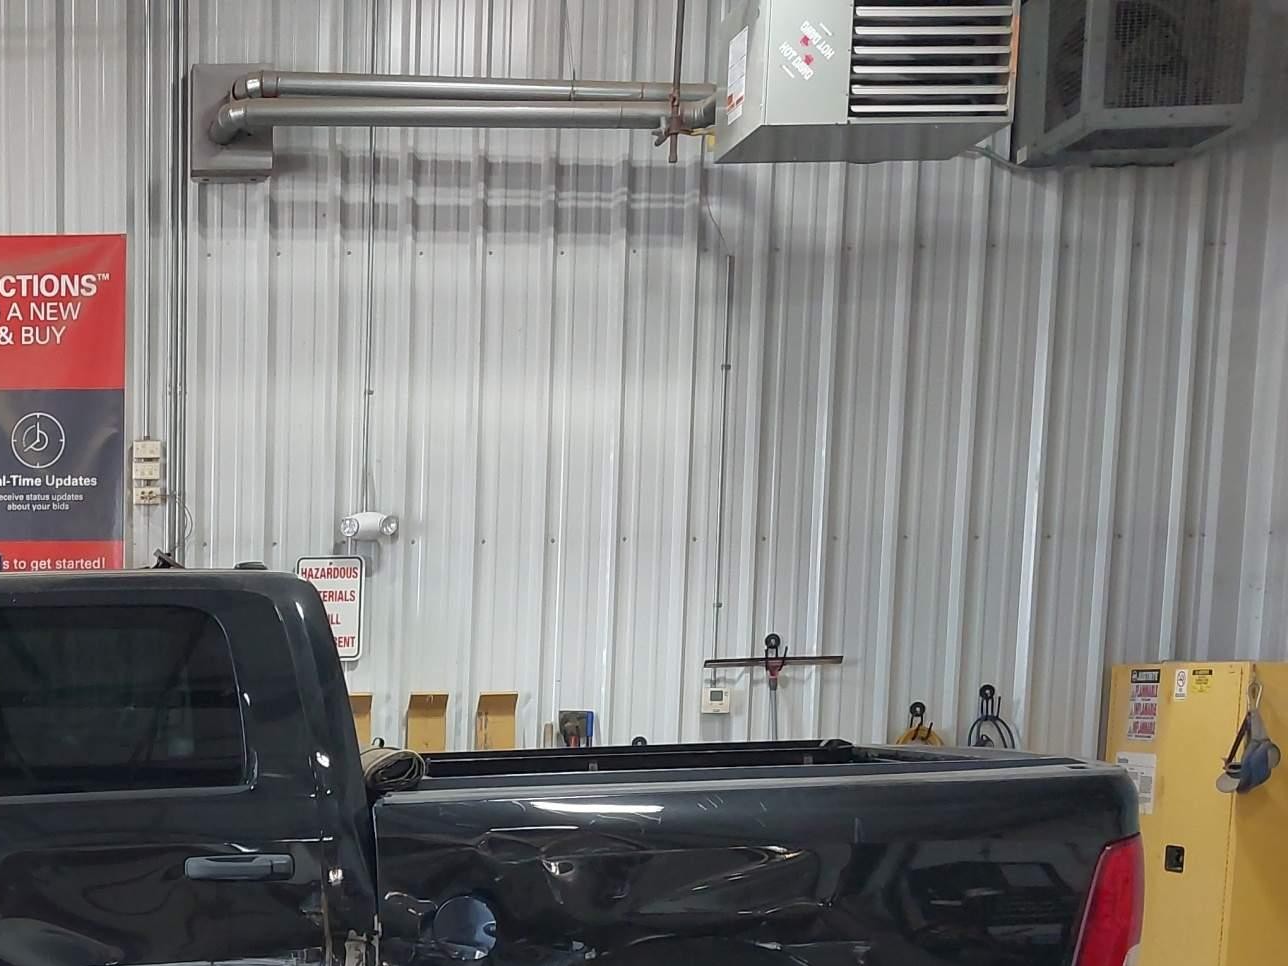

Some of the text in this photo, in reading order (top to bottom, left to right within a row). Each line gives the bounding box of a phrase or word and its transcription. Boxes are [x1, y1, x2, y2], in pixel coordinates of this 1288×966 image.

[7, 302, 23, 321] A
[30, 301, 82, 321] NEW
[21, 326, 66, 345] BUY
[45, 475, 97, 488] Updates
[26, 493, 50, 501] status
[52, 493, 83, 502] updates
[7, 502, 69, 512] about your bids
[13, 559, 27, 570] to
[30, 558, 52, 571] get
[55, 557, 106, 570] started!
[301, 567, 359, 579] HAZARDOUS
